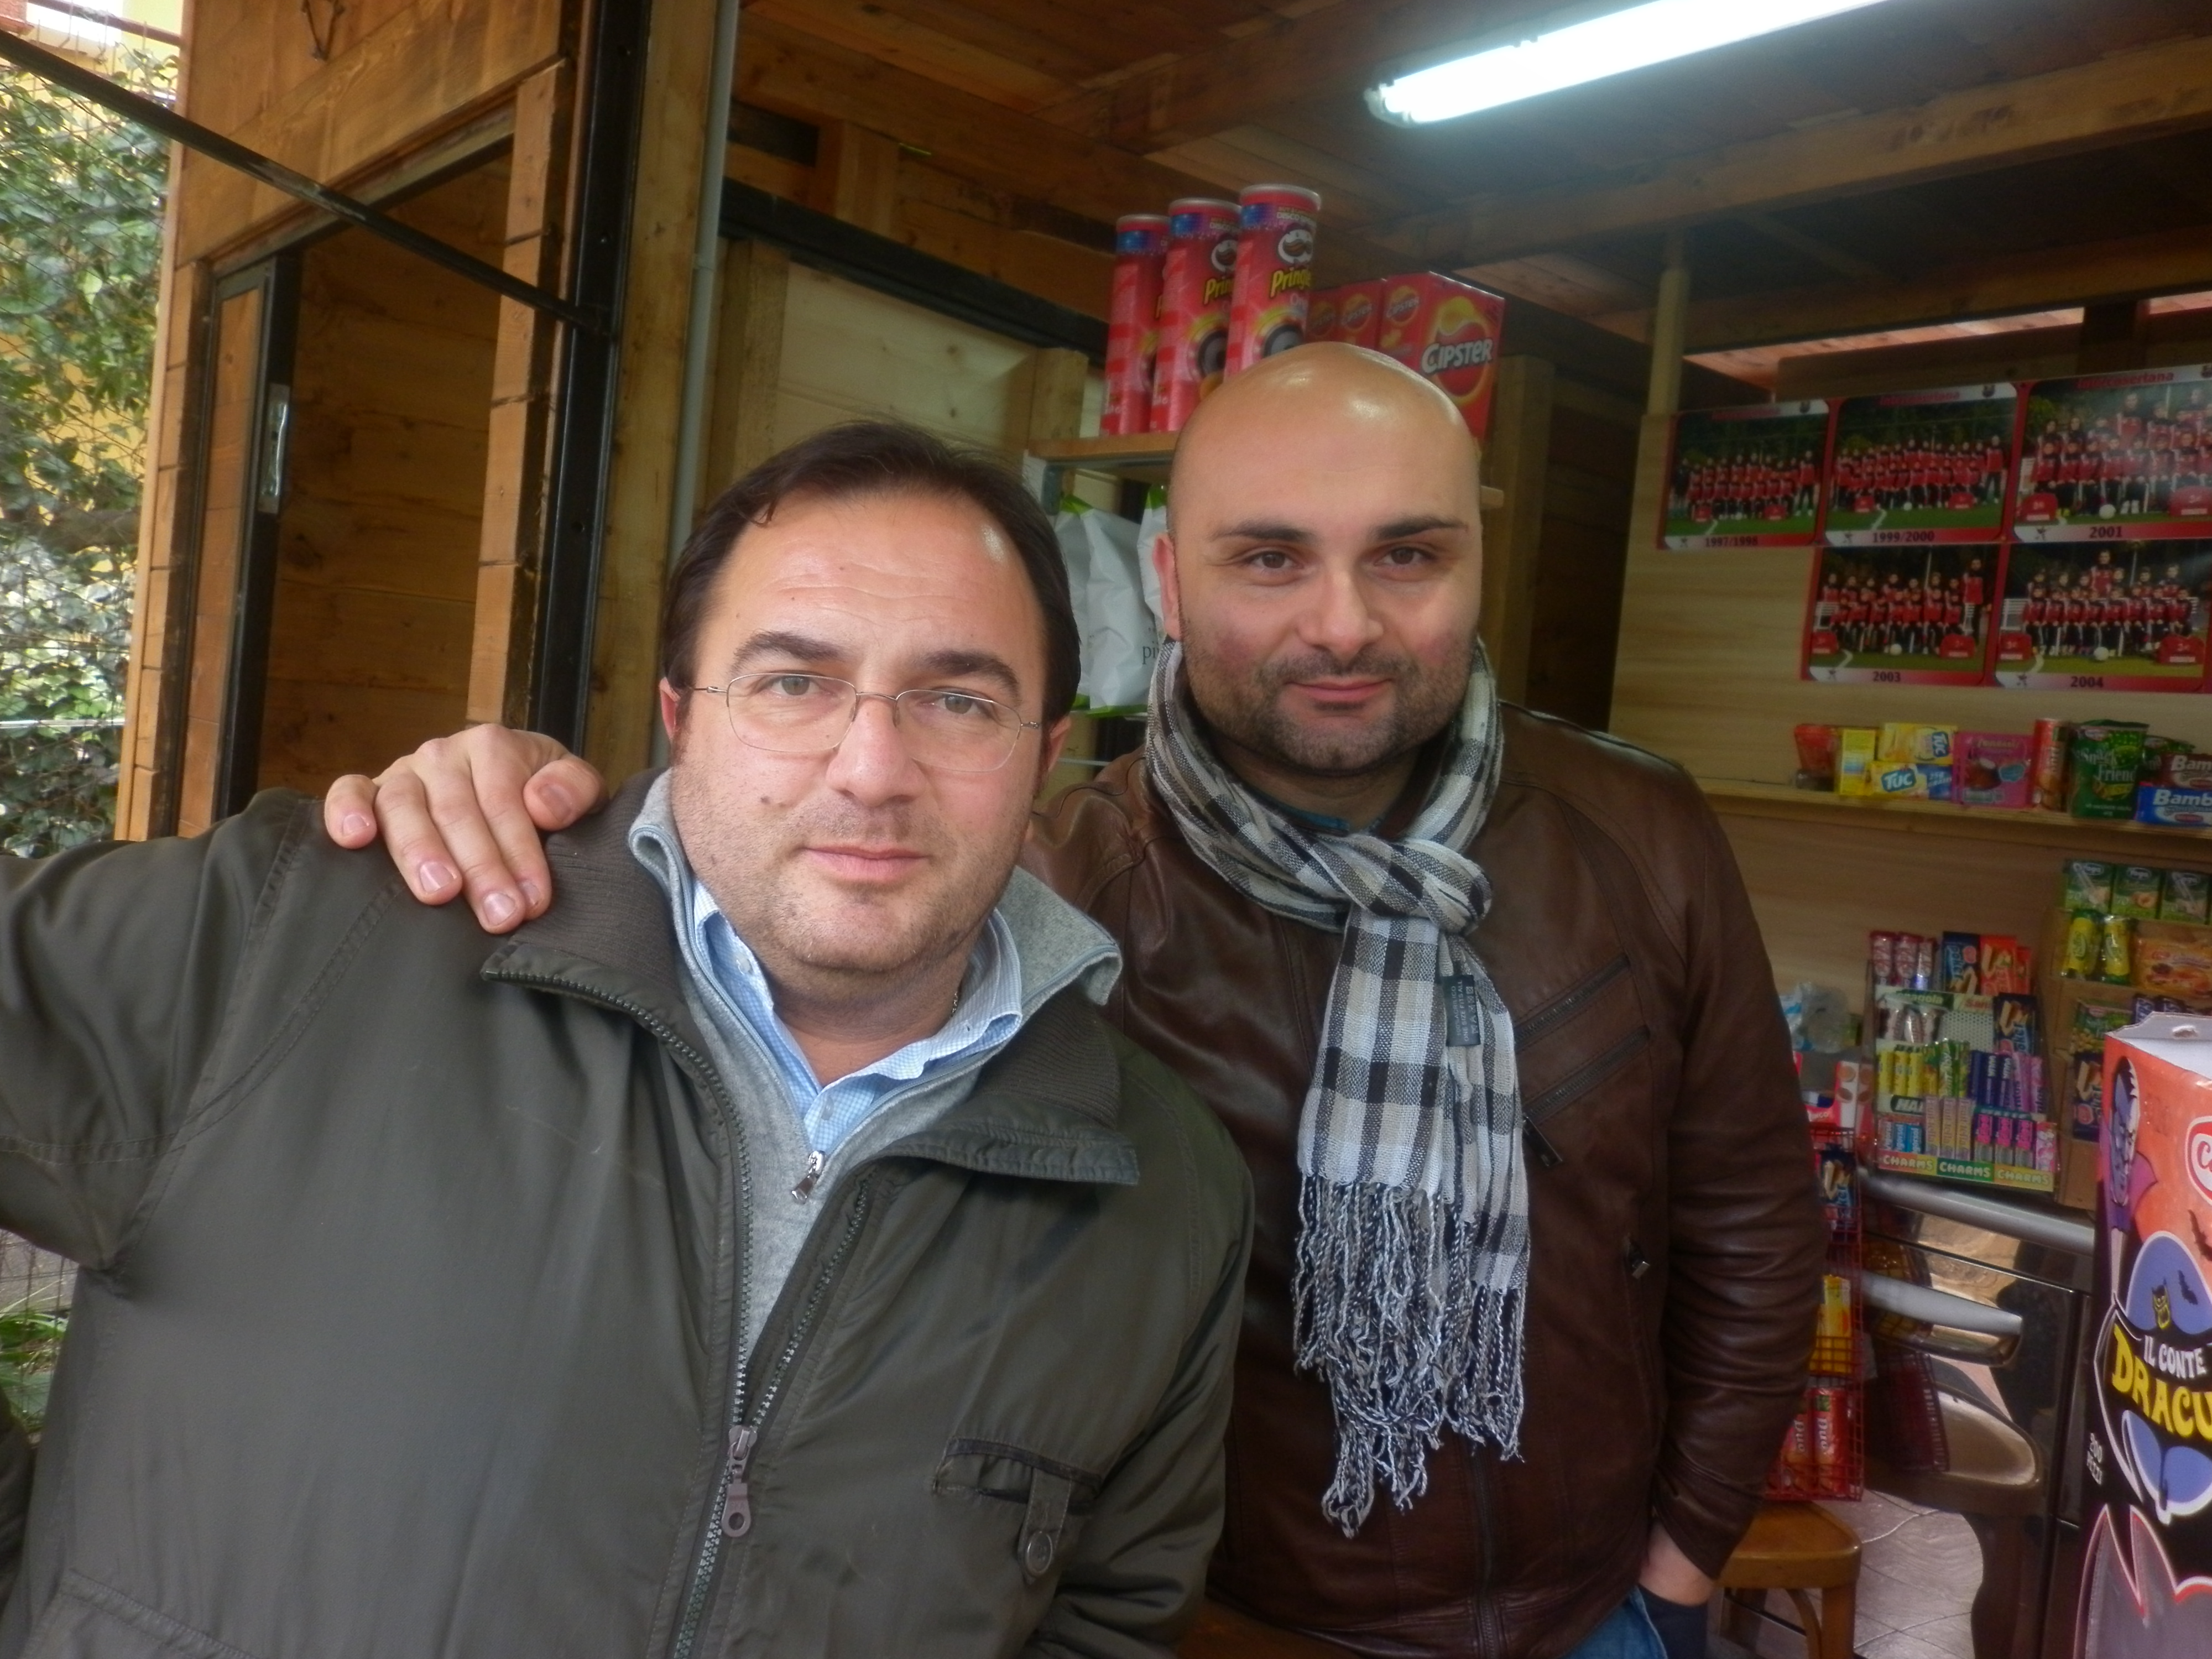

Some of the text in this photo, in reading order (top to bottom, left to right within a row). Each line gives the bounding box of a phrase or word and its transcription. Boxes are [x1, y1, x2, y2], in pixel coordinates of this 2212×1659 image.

[1872, 530, 1935, 543] 1999/2000
[2089, 526, 2123, 539] 2001
[1872, 671, 1901, 682] 2003
[2070, 676, 2104, 688] 2004
[1883, 774, 1913, 790] TUC
[1882, 1155, 1933, 1171] CHARMS
[1939, 1161, 1991, 1178] CHARMS
[1996, 1168, 2050, 1185] CHARMS
[2143, 1334, 2207, 1379] IL CONTE
